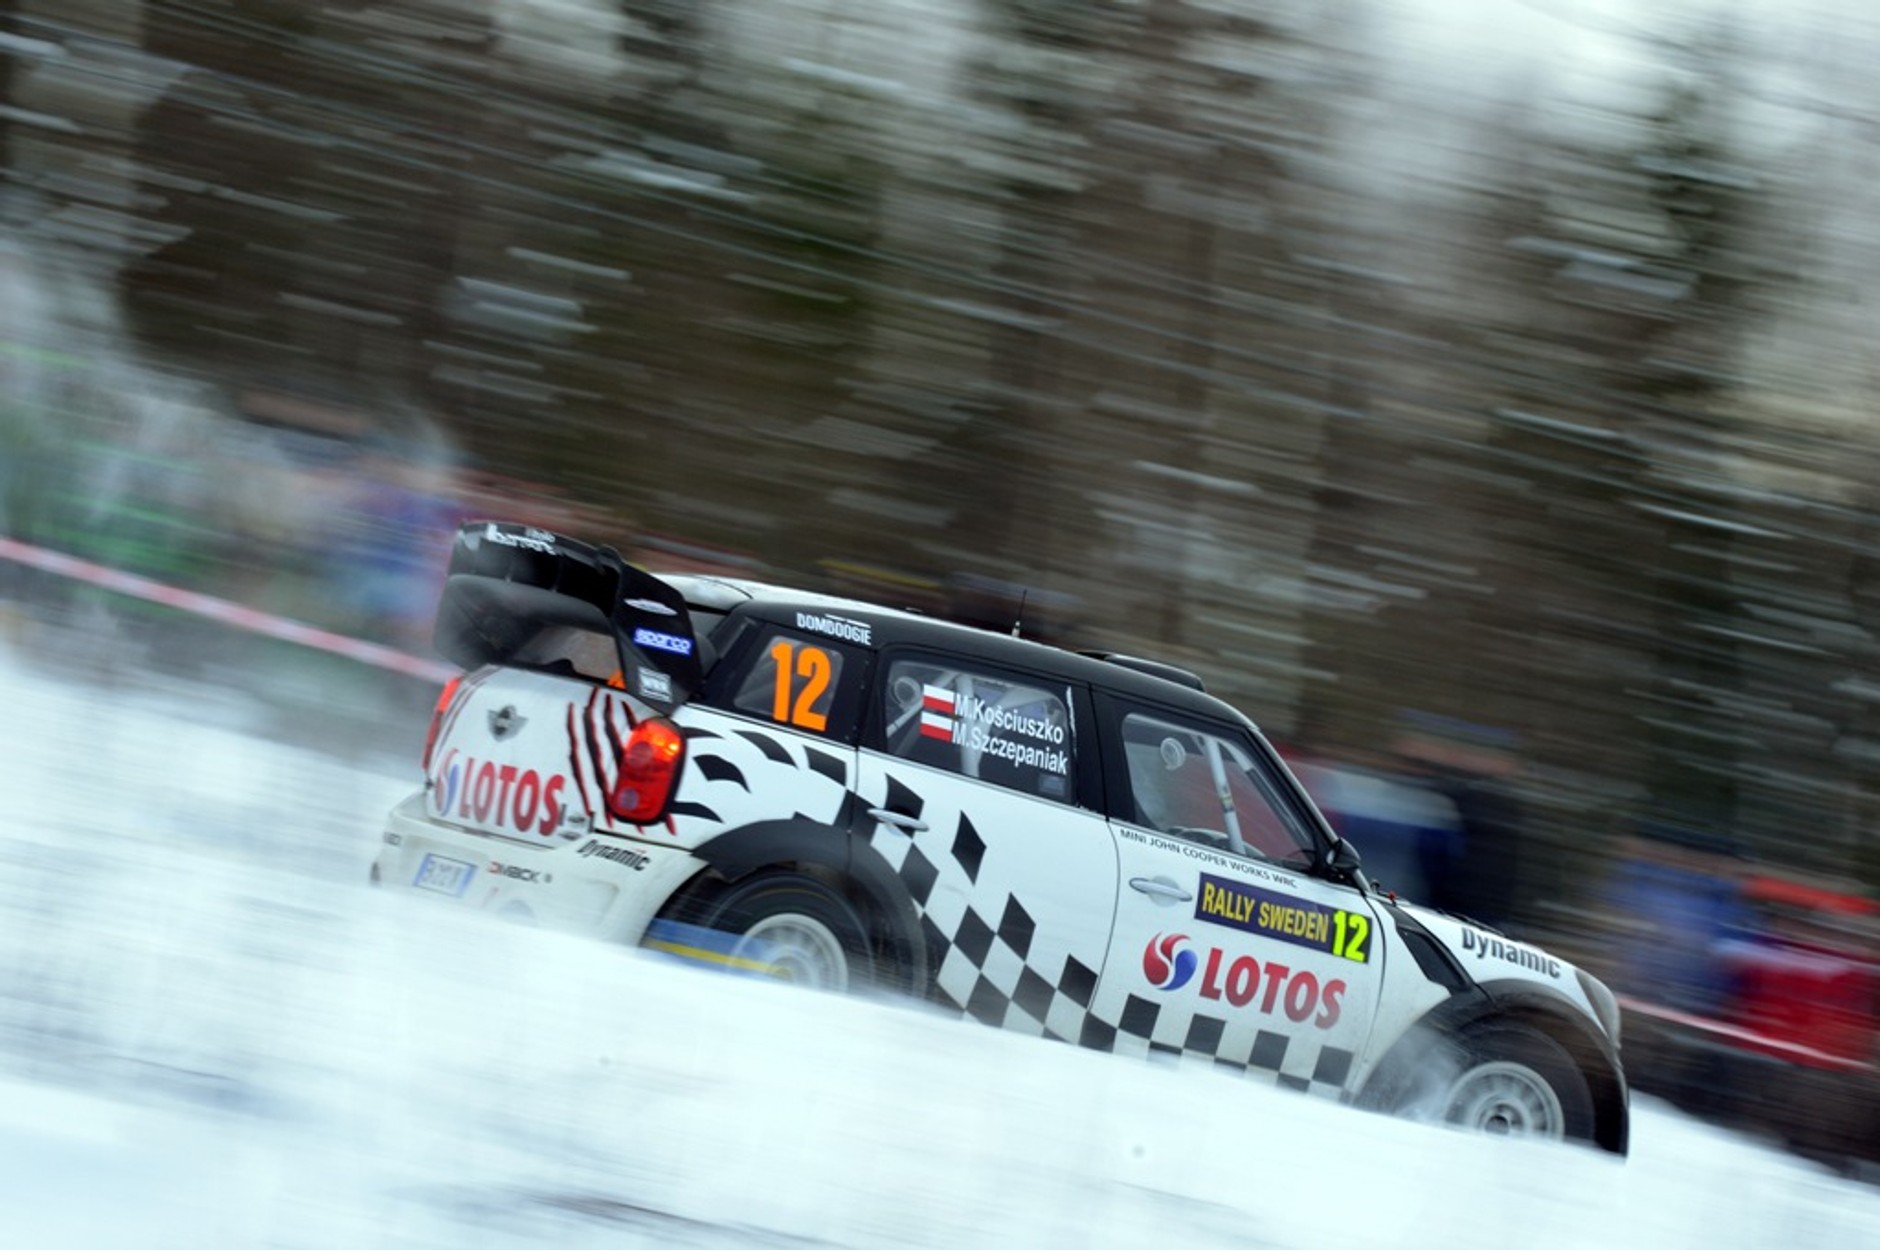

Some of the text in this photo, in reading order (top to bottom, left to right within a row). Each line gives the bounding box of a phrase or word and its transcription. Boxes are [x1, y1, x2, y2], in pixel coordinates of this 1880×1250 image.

[770, 642, 832, 732] 12
[952, 721, 1069, 775] M.Szczepaniak
[954, 693, 1064, 745] M.Kościuszko
[458, 757, 566, 837] LOTOS
[576, 838, 651, 872] Dynamic
[1120, 828, 1298, 890] MINI JOHN COOPER WORKS WRC
[1202, 881, 1369, 963] RALLY SWEDEN 12
[1461, 926, 1562, 979] Dynamic
[1198, 946, 1347, 1031] LOTOS
